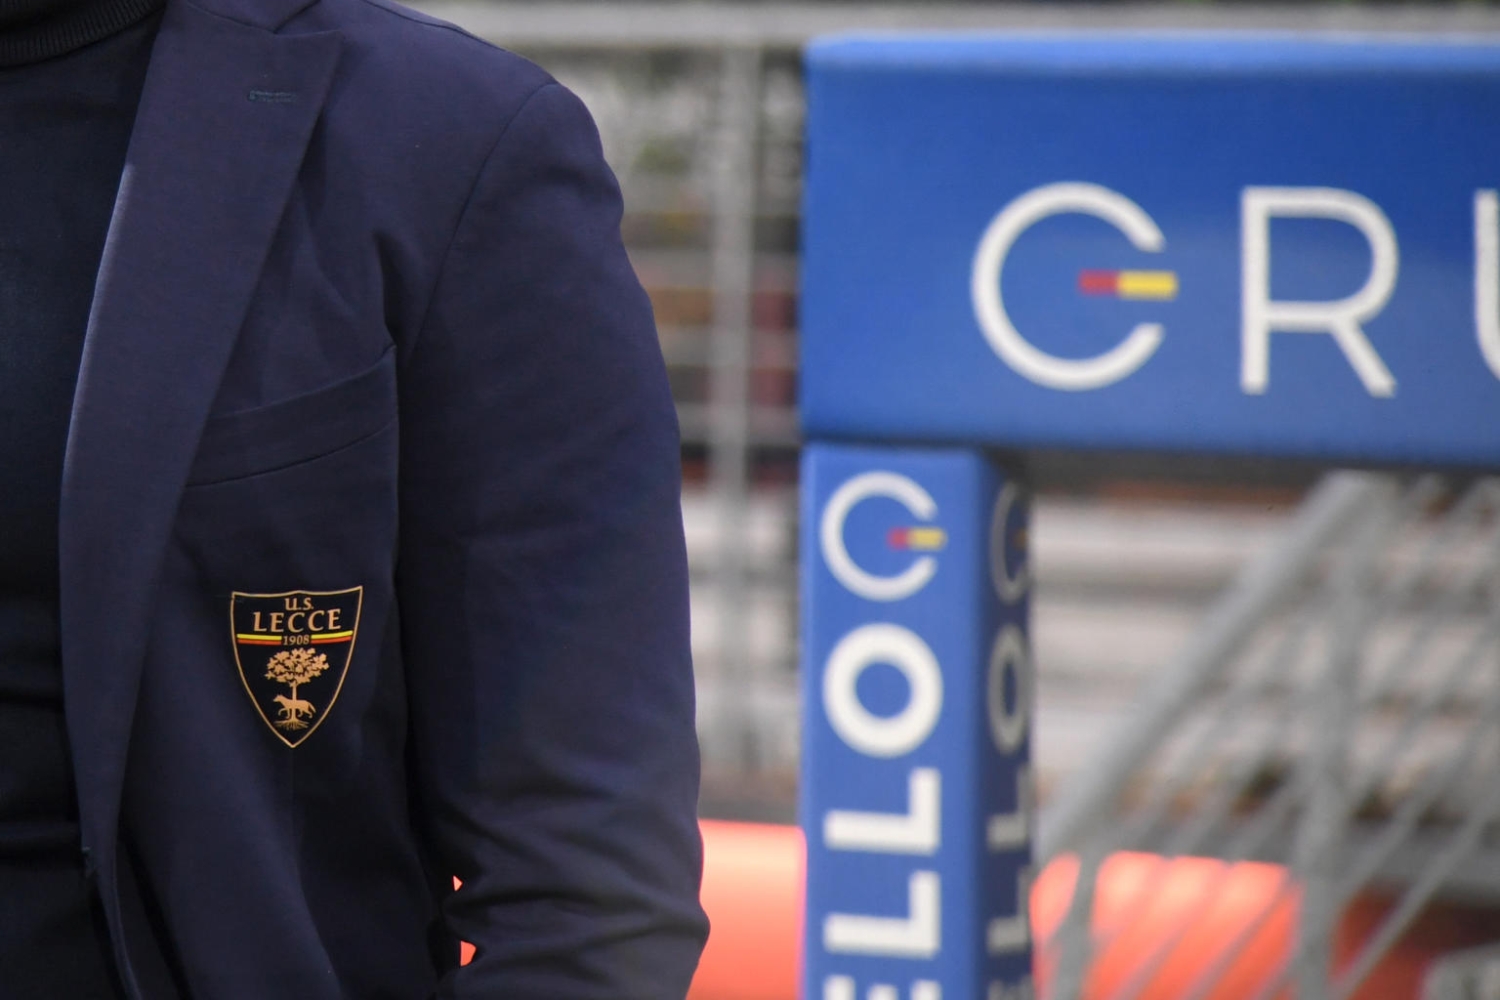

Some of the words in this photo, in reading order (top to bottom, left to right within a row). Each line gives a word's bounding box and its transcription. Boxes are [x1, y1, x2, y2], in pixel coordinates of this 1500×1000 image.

[253, 608, 342, 633] LECCE
[283, 634, 310, 646] 1908
[822, 622, 943, 1000] LLO
